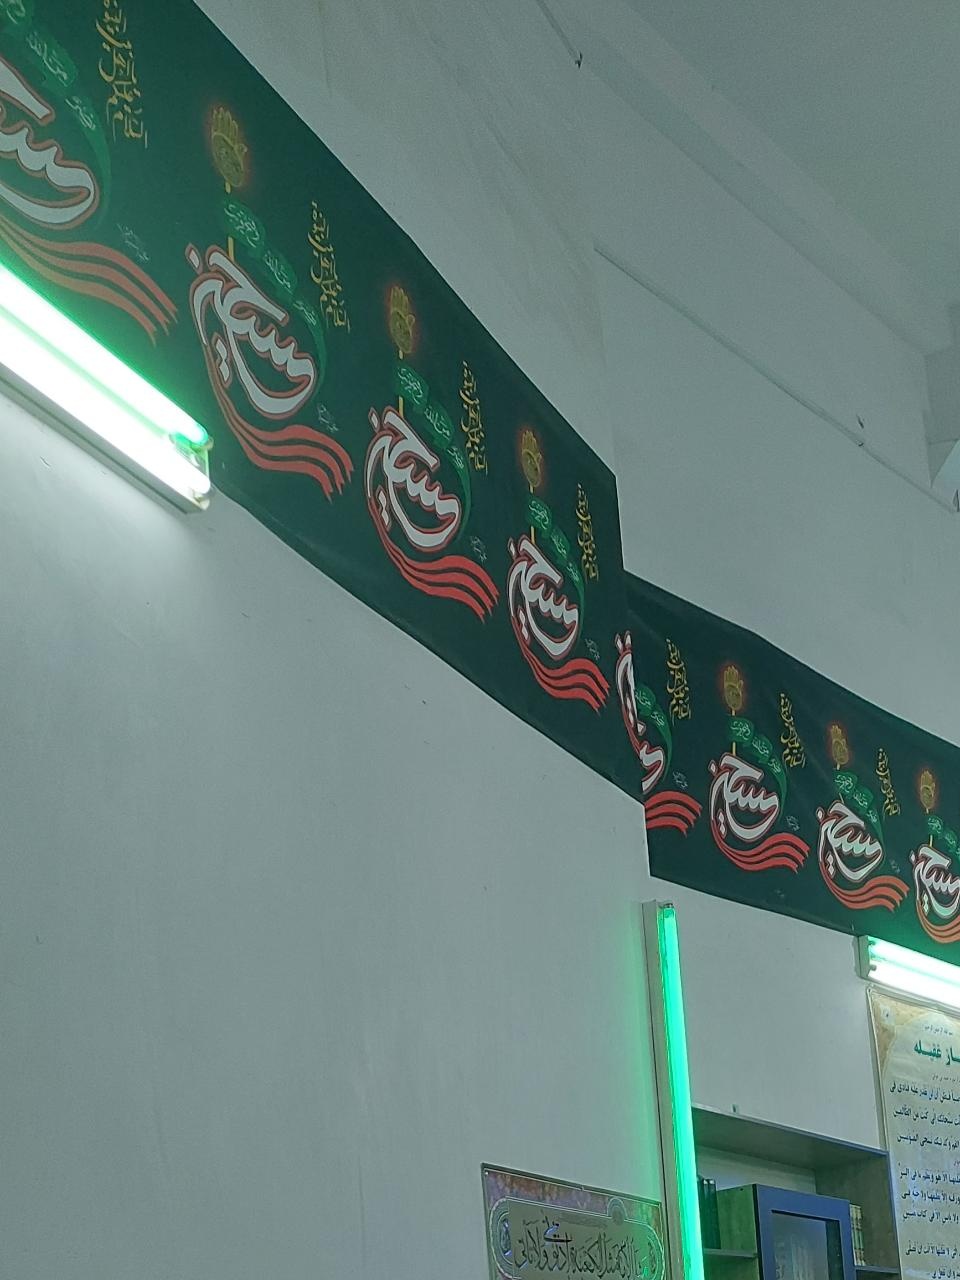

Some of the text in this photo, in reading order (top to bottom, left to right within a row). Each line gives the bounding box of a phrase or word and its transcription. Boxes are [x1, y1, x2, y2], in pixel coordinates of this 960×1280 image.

[185, 242, 318, 415] حسین
[365, 405, 461, 550] حسین
[507, 534, 581, 659] حسین
[709, 751, 780, 840] حسین
[817, 799, 883, 880] حسین
[912, 1037, 942, 1062] غفیله
